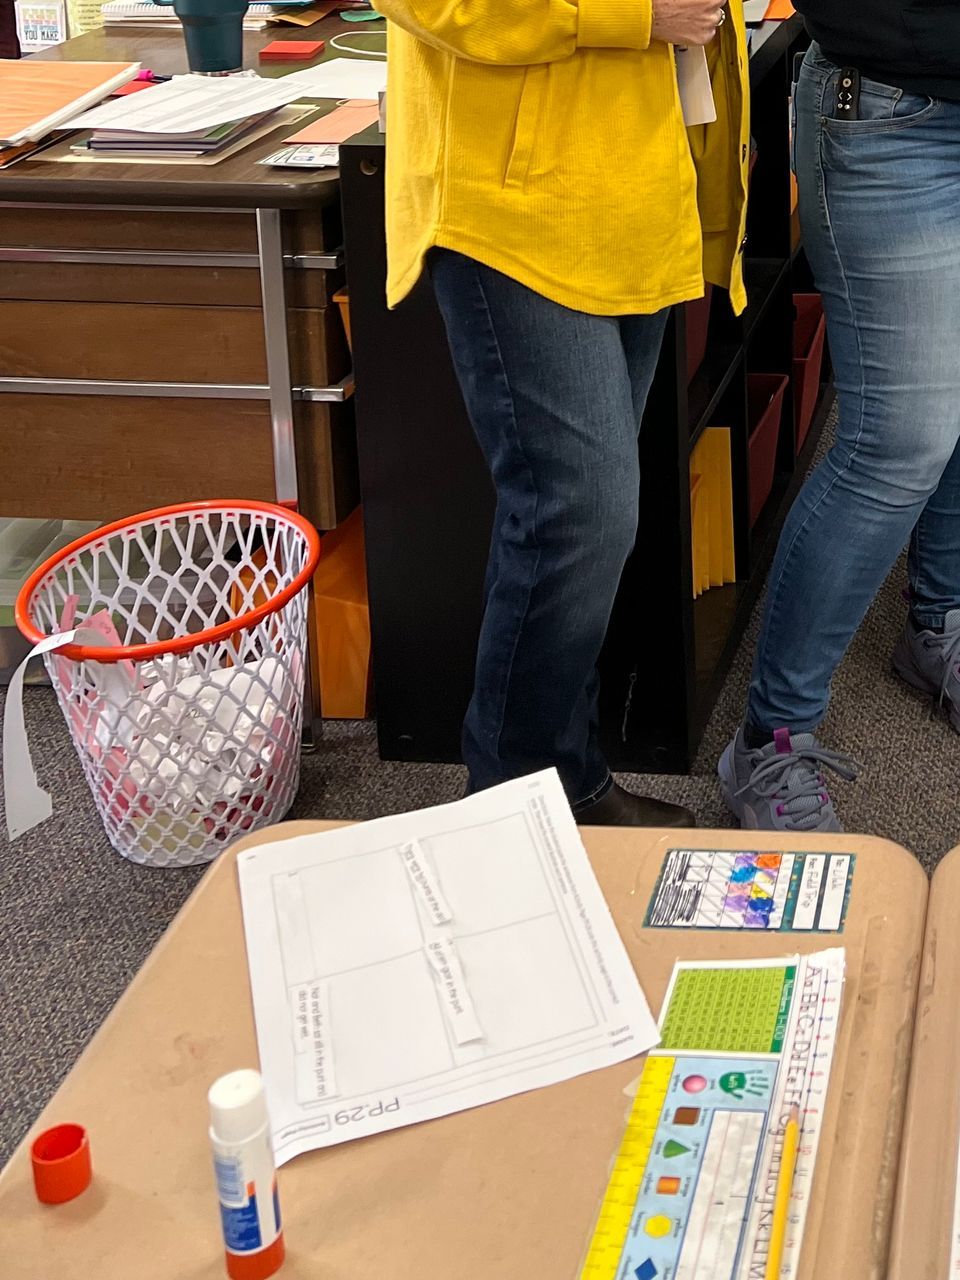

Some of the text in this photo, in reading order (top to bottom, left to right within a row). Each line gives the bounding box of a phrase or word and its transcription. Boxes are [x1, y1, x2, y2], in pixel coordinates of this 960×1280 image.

[24, 30, 59, 40] YOU MAKE
[335, 1096, 400, 1126] PP.29
